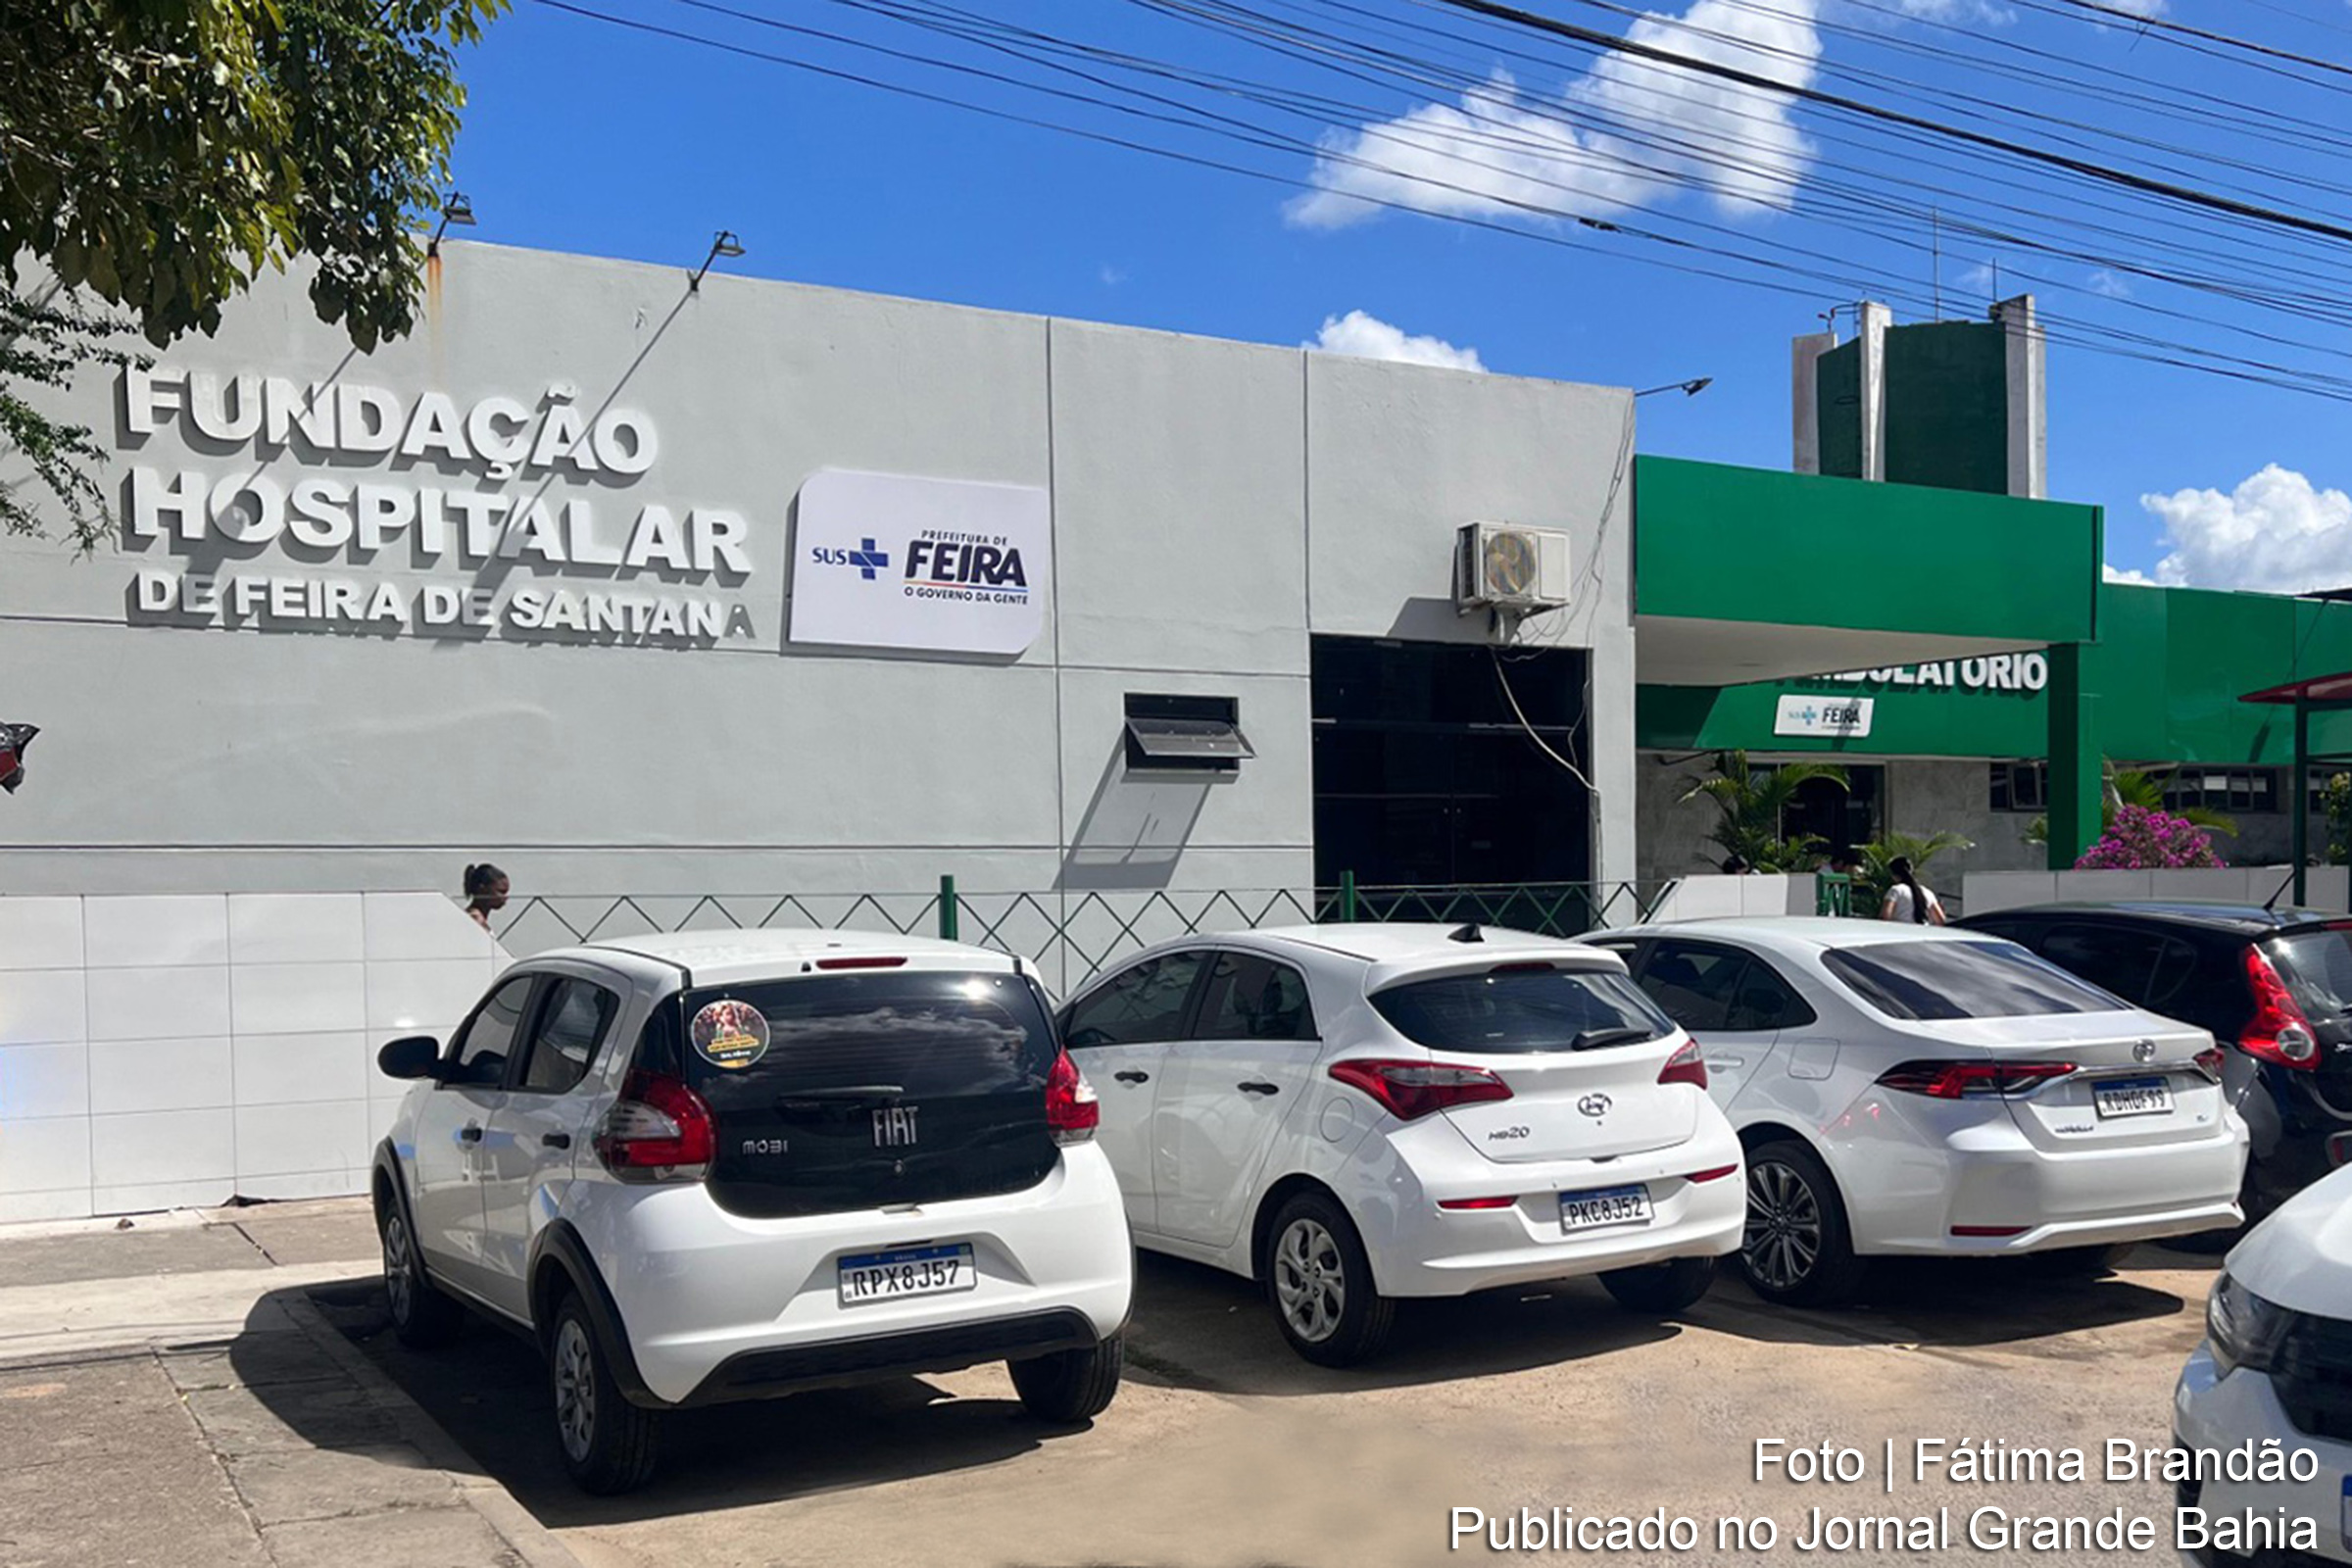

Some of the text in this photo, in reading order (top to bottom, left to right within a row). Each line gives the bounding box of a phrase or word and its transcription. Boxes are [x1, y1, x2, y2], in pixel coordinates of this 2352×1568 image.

[126, 366, 660, 480] FUNDAÇÃO
[132, 466, 753, 573] HOSPITALAR
[921, 530, 1007, 546] PREFEITURA DE
[811, 547, 847, 565] SUS
[905, 540, 1027, 587] FEIRA
[136, 569, 756, 639] DE FEIRA DE SANTANA
[905, 586, 1028, 605] O GOVERNO DA GENTE
[1822, 707, 1861, 723] FEIRA
[872, 1106, 918, 1147] FIAT
[743, 1140, 788, 1153] MOBI
[1569, 1197, 1643, 1224] PKC8J52
[853, 1259, 959, 1296] RPX8J57
